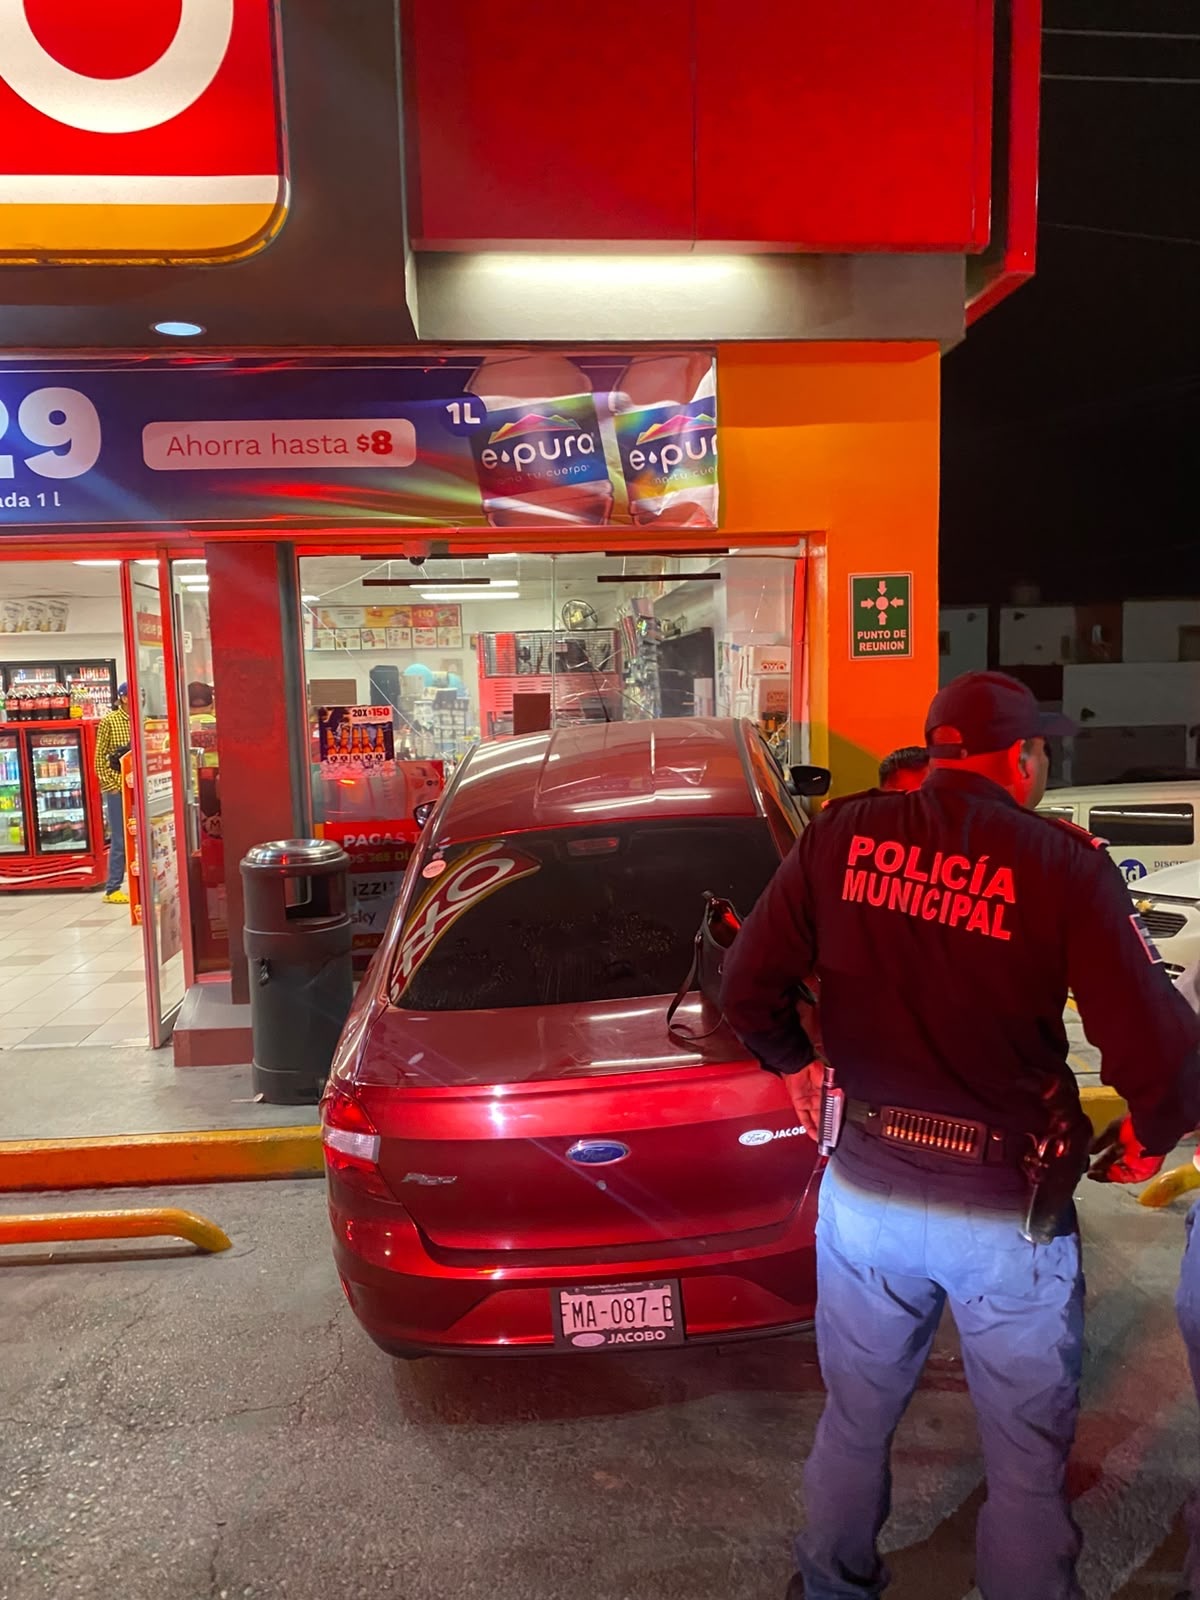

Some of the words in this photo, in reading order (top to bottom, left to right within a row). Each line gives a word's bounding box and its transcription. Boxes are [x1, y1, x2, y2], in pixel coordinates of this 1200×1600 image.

[446, 402, 481, 425] 1L
[167, 436, 261, 457] Ahorra
[272, 432, 348, 455] hasta
[356, 429, 393, 456] $8
[857, 630, 891, 640] PUNTO
[893, 629, 907, 638] DE
[859, 640, 905, 652] REUNION
[352, 709, 368, 718] 20X
[368, 707, 390, 717] $150
[343, 831, 407, 848] PAGAS
[847, 835, 1016, 904] POLICÍA
[842, 869, 1012, 940] MUNICIPAL
[773, 1126, 807, 1140] JACOB
[607, 1330, 667, 1345] JACOBO
